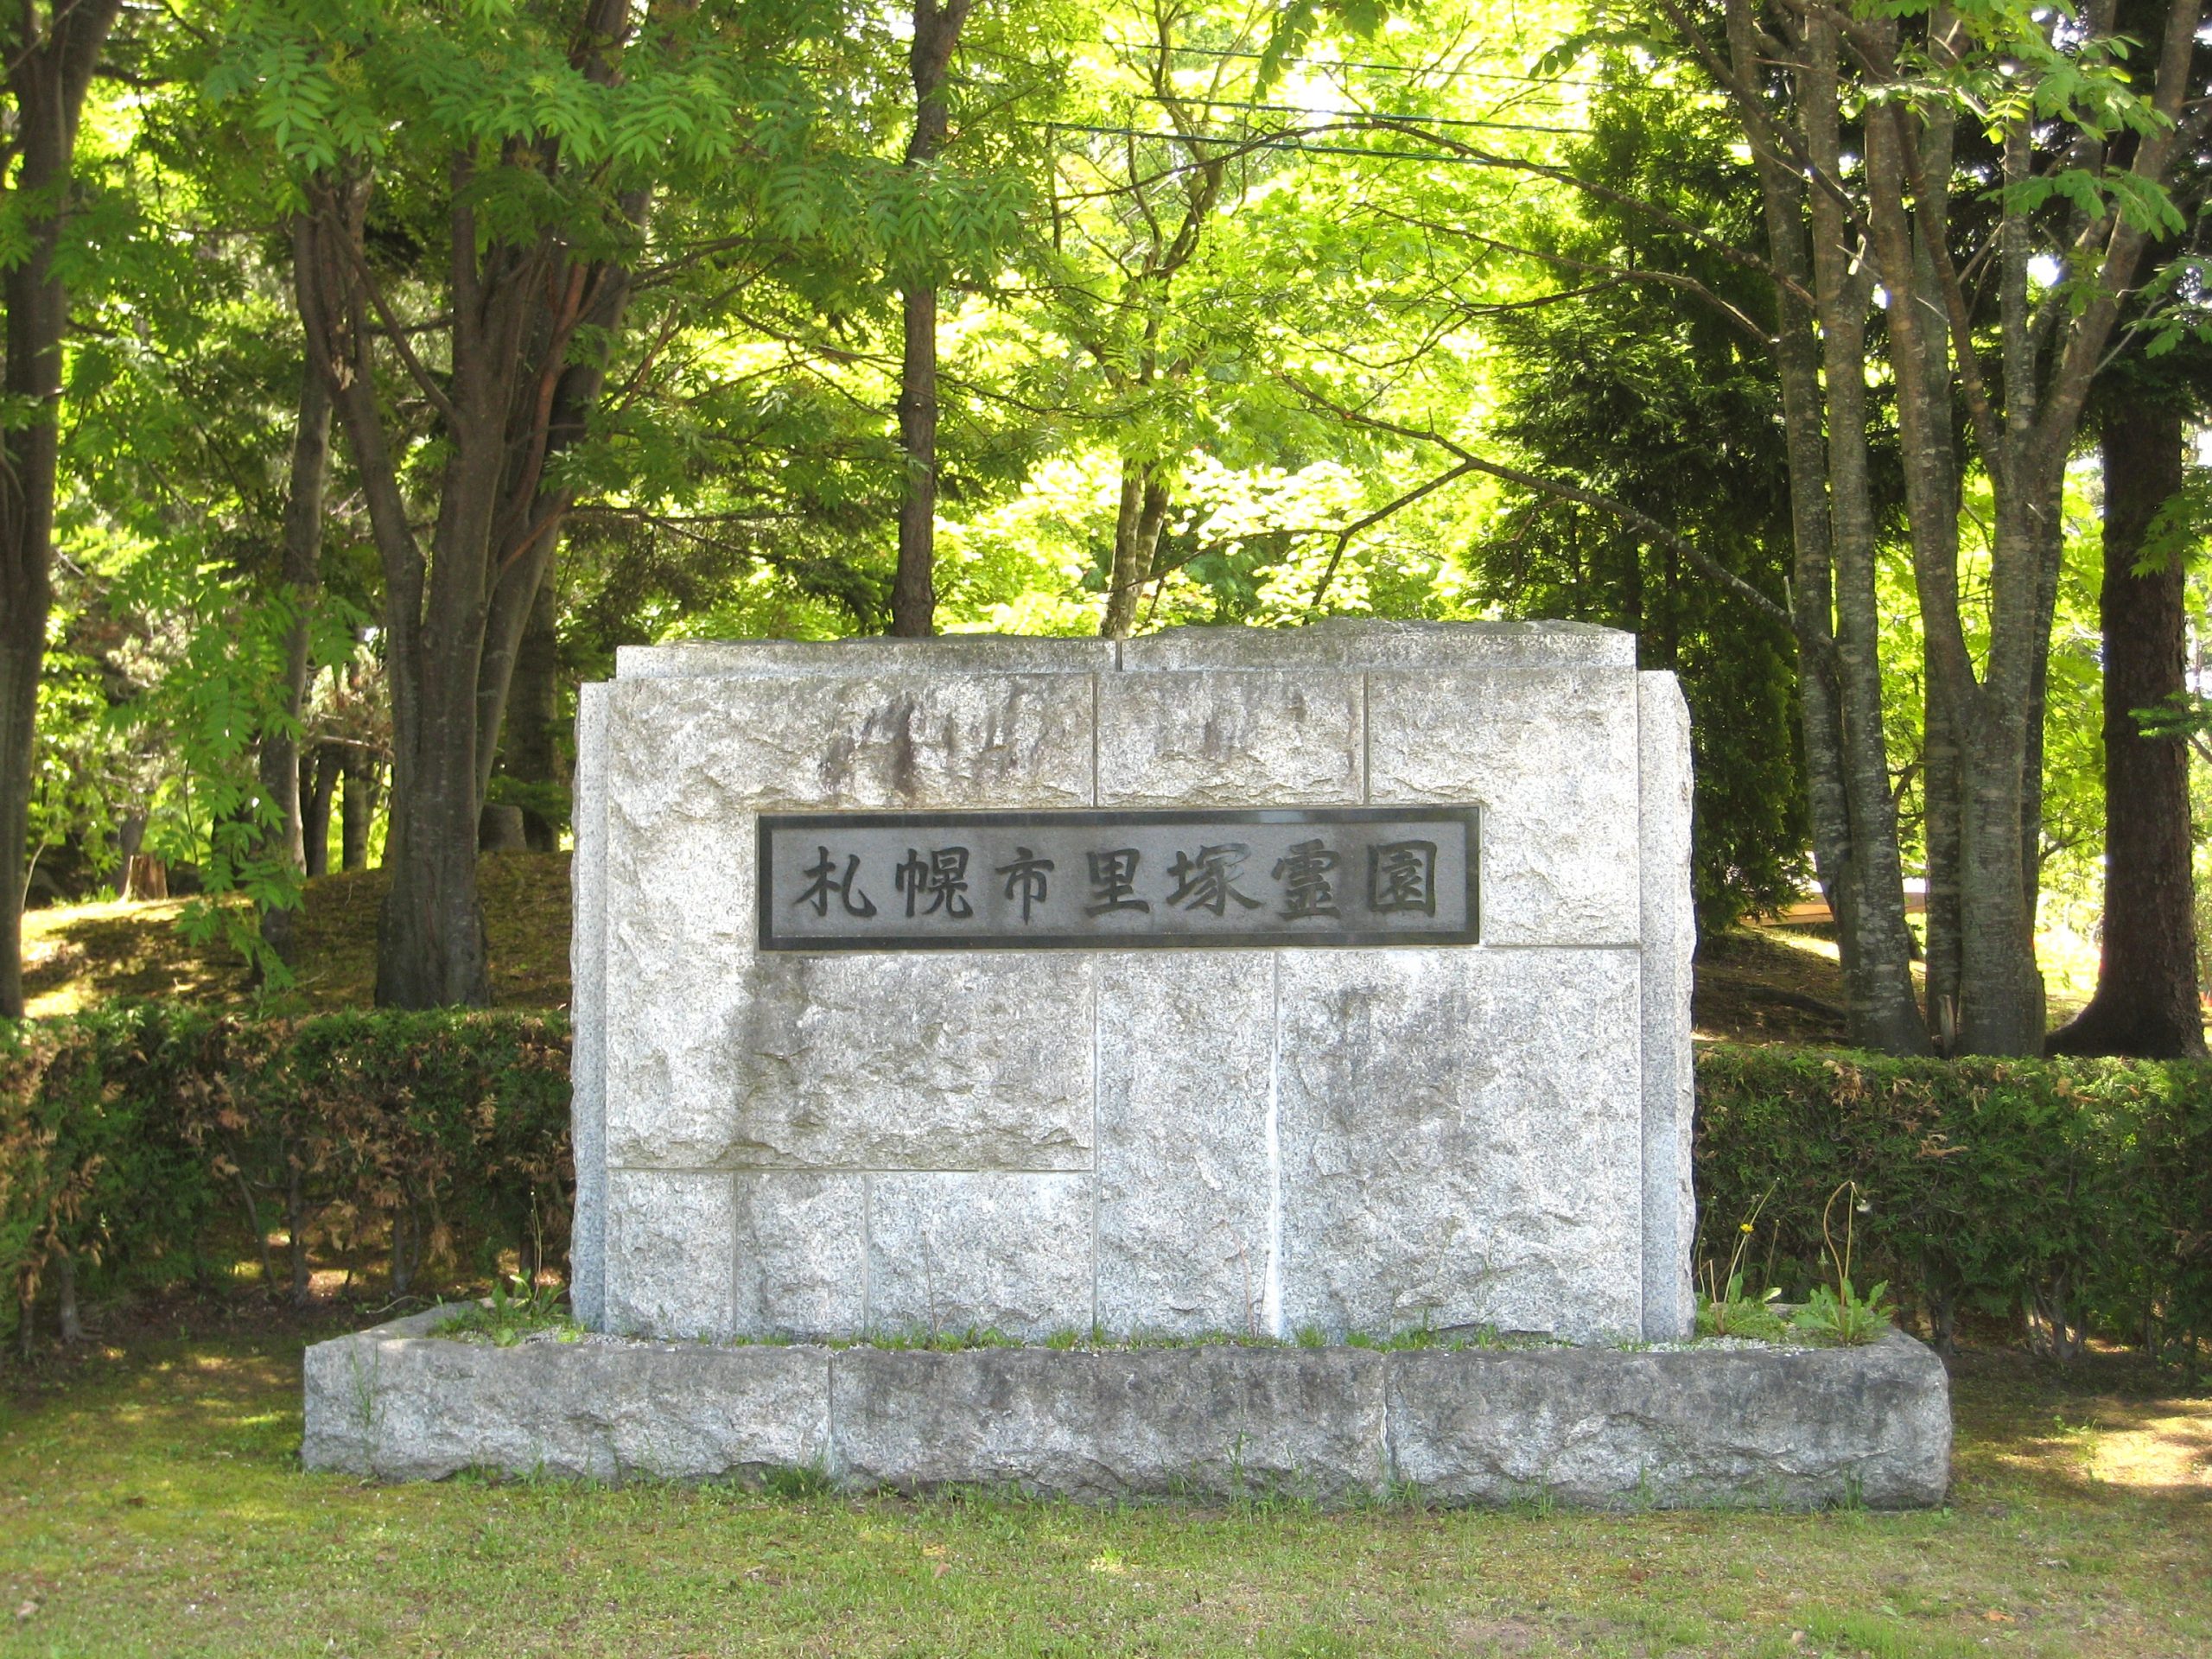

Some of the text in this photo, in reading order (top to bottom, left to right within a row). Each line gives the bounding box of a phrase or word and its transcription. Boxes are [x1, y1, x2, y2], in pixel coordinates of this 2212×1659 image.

[793, 837, 1437, 922] 札幌市里塚霊園
